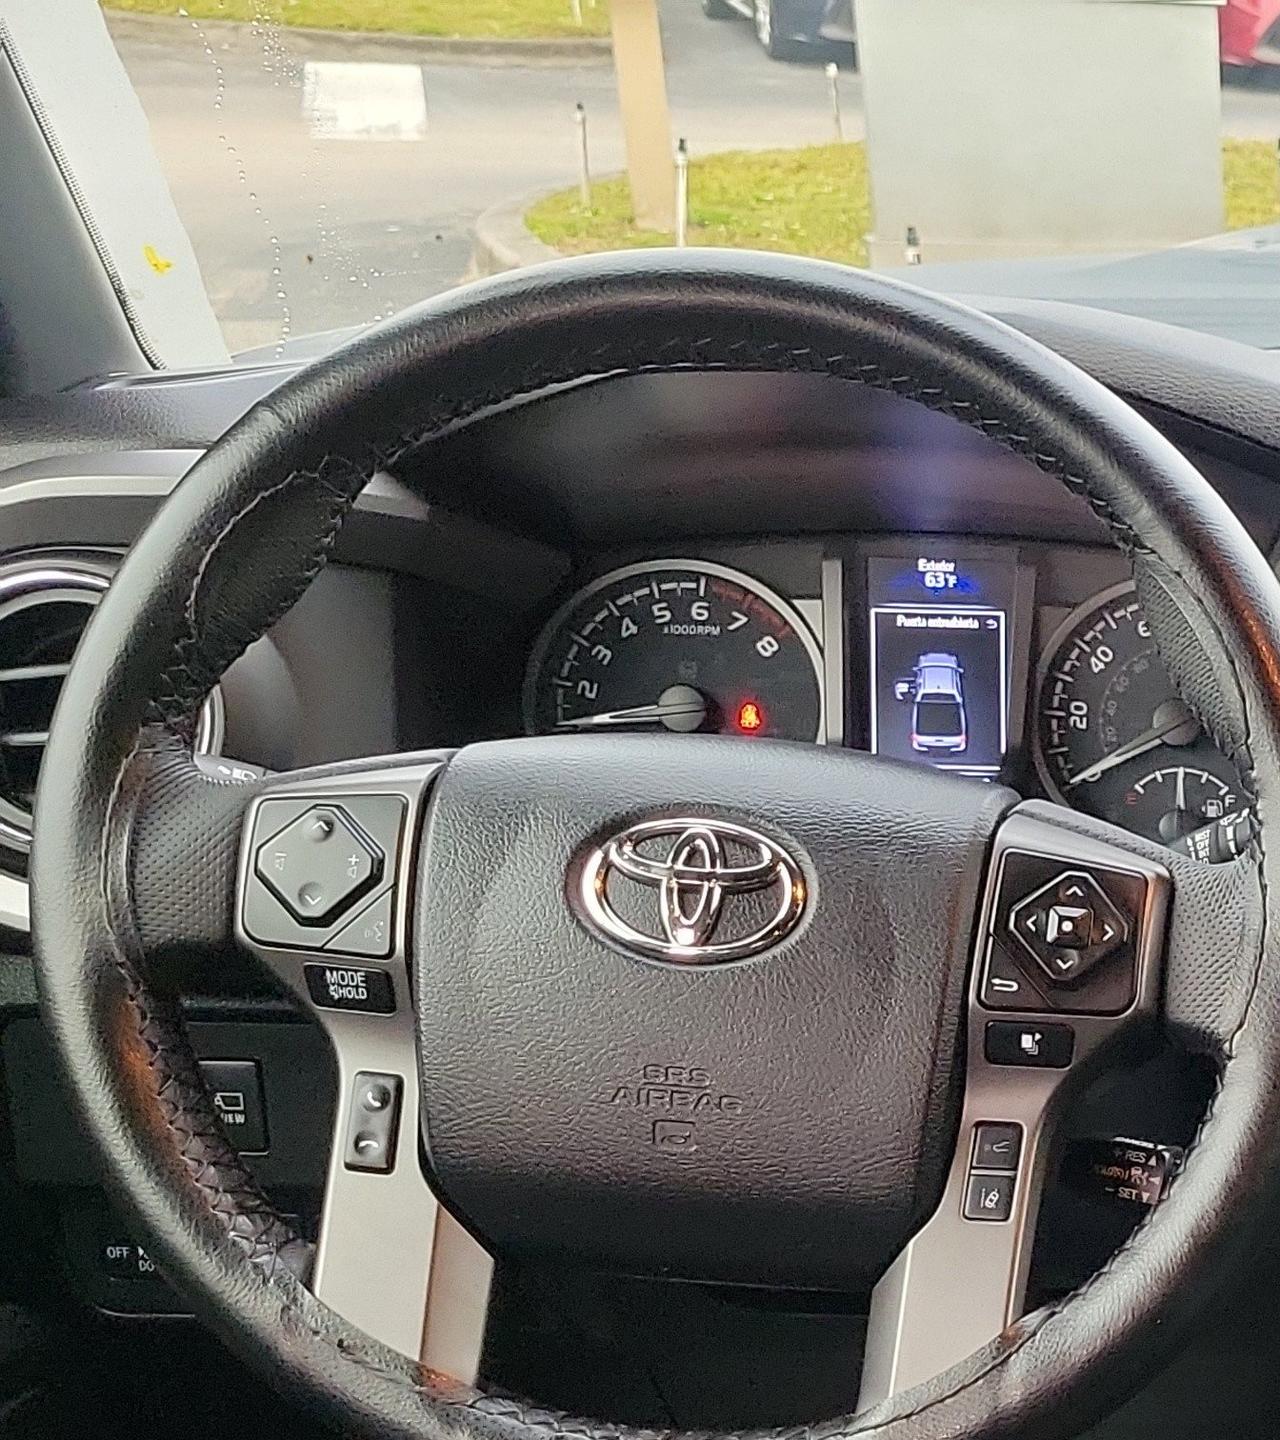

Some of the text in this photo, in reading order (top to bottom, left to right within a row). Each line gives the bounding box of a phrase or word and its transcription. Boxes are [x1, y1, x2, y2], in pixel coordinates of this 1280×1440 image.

[651, 602, 672, 624] 5
[691, 601, 710, 622] 6
[727, 611, 750, 631] 7
[621, 616, 639, 638] 4
[591, 645, 613, 666] 3
[755, 635, 780, 658] 8
[1089, 645, 1115, 674] 40
[577, 680, 598, 699] 2
[1069, 701, 1089, 730] 20
[325, 968, 367, 987] MODE
[339, 986, 368, 1000] HOLD
[106, 1246, 130, 1259] OFF
